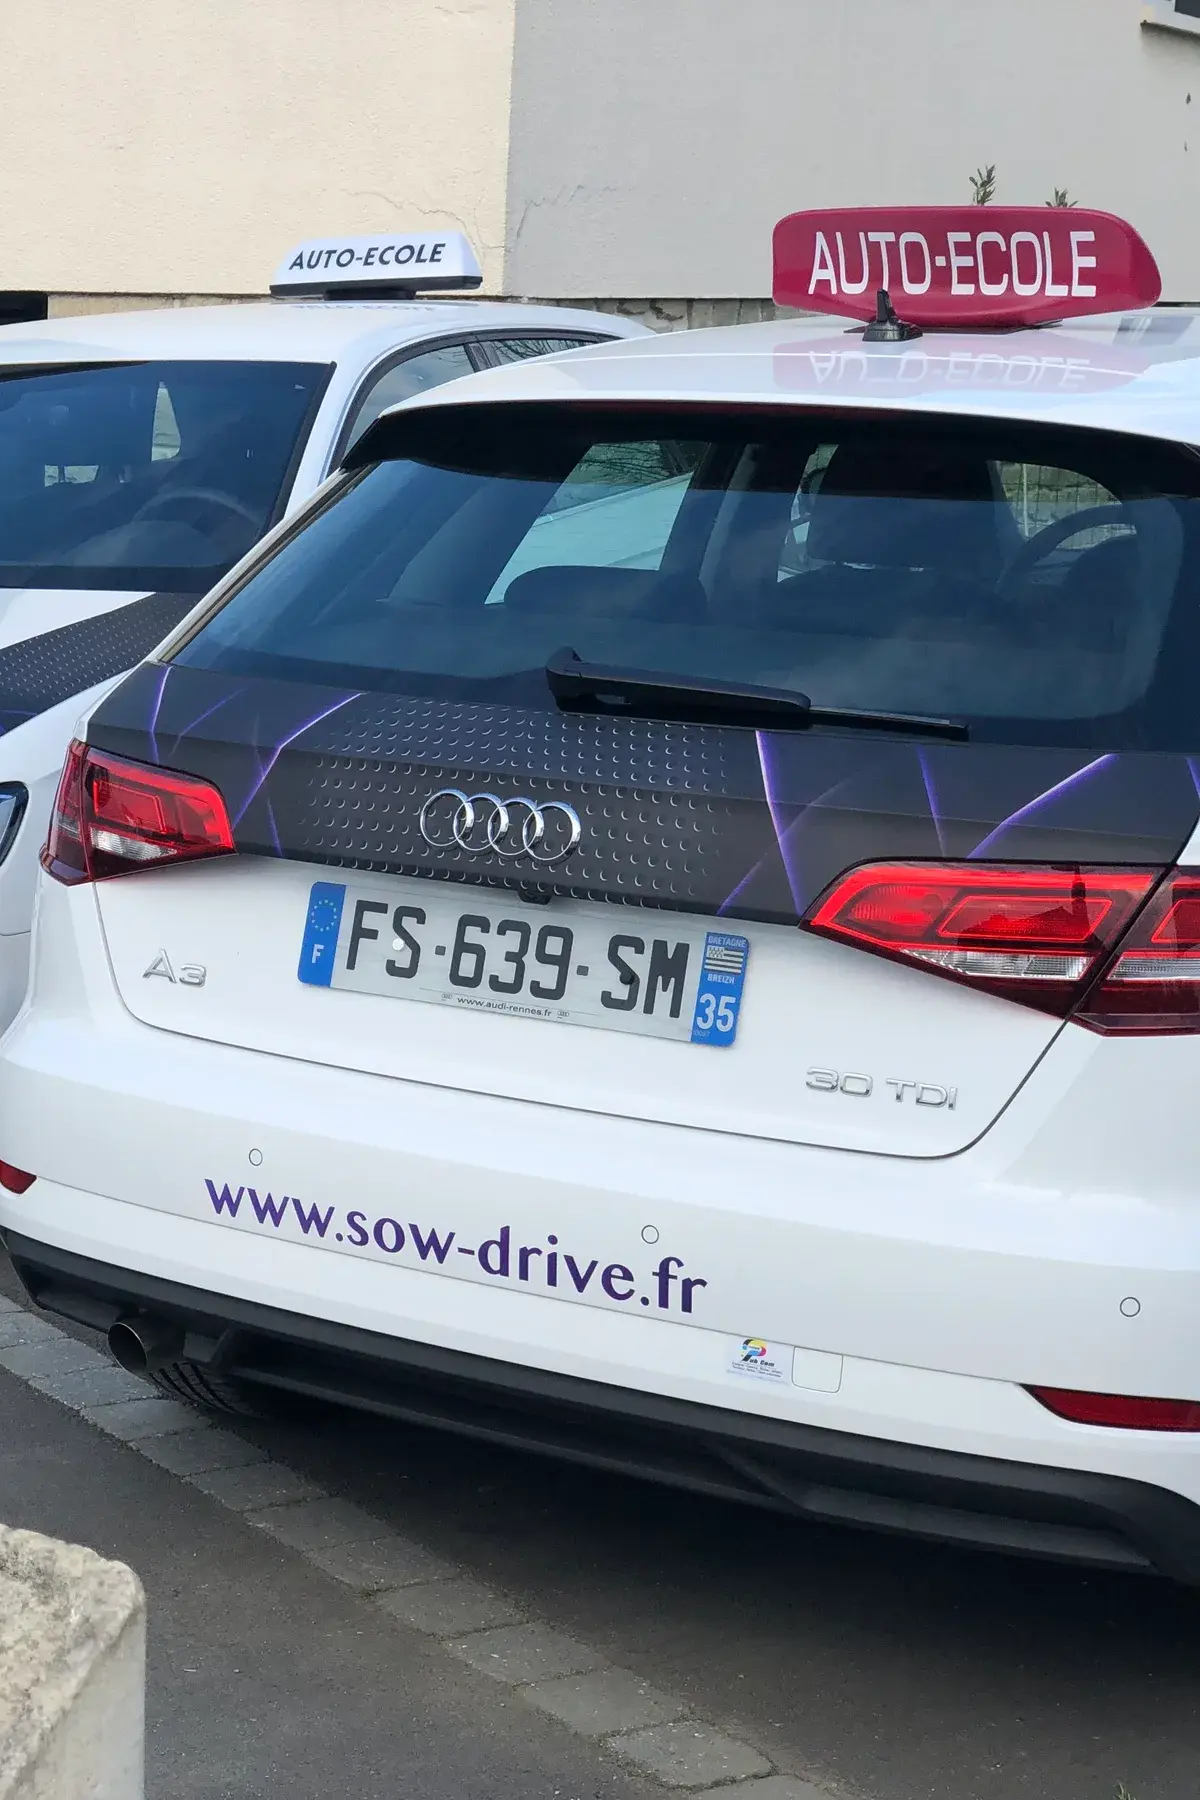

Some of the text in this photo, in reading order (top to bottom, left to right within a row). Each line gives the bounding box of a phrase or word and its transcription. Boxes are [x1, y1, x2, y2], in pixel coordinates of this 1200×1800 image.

[289, 243, 446, 270] AUTO-ECOLE
[808, 231, 1097, 297] AUTO-ECOLE
[312, 944, 324, 963] F
[708, 936, 747, 948] BRETAGNE
[142, 948, 206, 988] A3
[707, 974, 735, 984] BREIZH
[457, 997, 552, 1017] www.audi-rennes.fr
[696, 993, 736, 1032] 35
[806, 1067, 958, 1110] 30 TDI
[204, 1178, 708, 1313] www.sow-drive.fr
